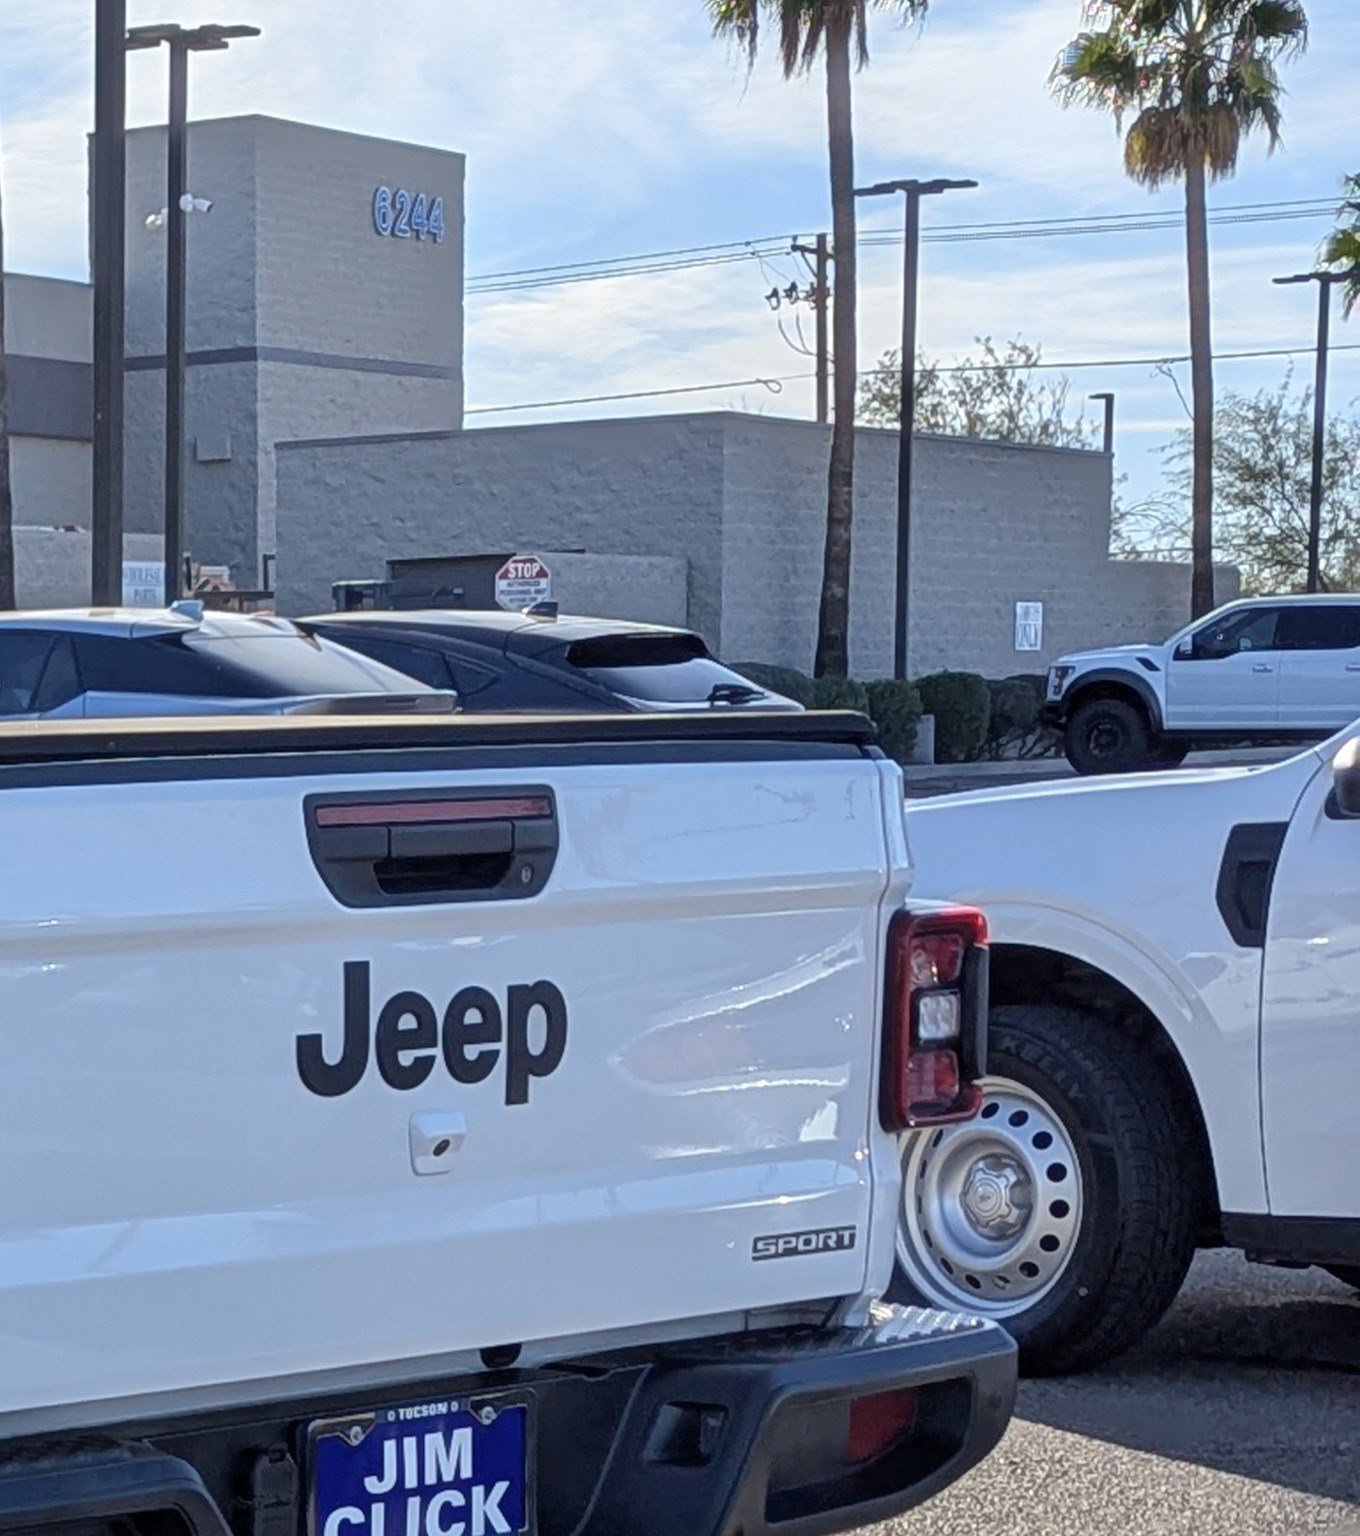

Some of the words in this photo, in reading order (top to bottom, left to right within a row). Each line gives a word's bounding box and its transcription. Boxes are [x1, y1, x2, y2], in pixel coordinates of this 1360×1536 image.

[373, 185, 445, 243] 6244
[508, 563, 540, 578] STOP
[295, 960, 568, 1106] Jeep
[752, 1228, 857, 1260] SPORT
[363, 1426, 473, 1495] JIM
